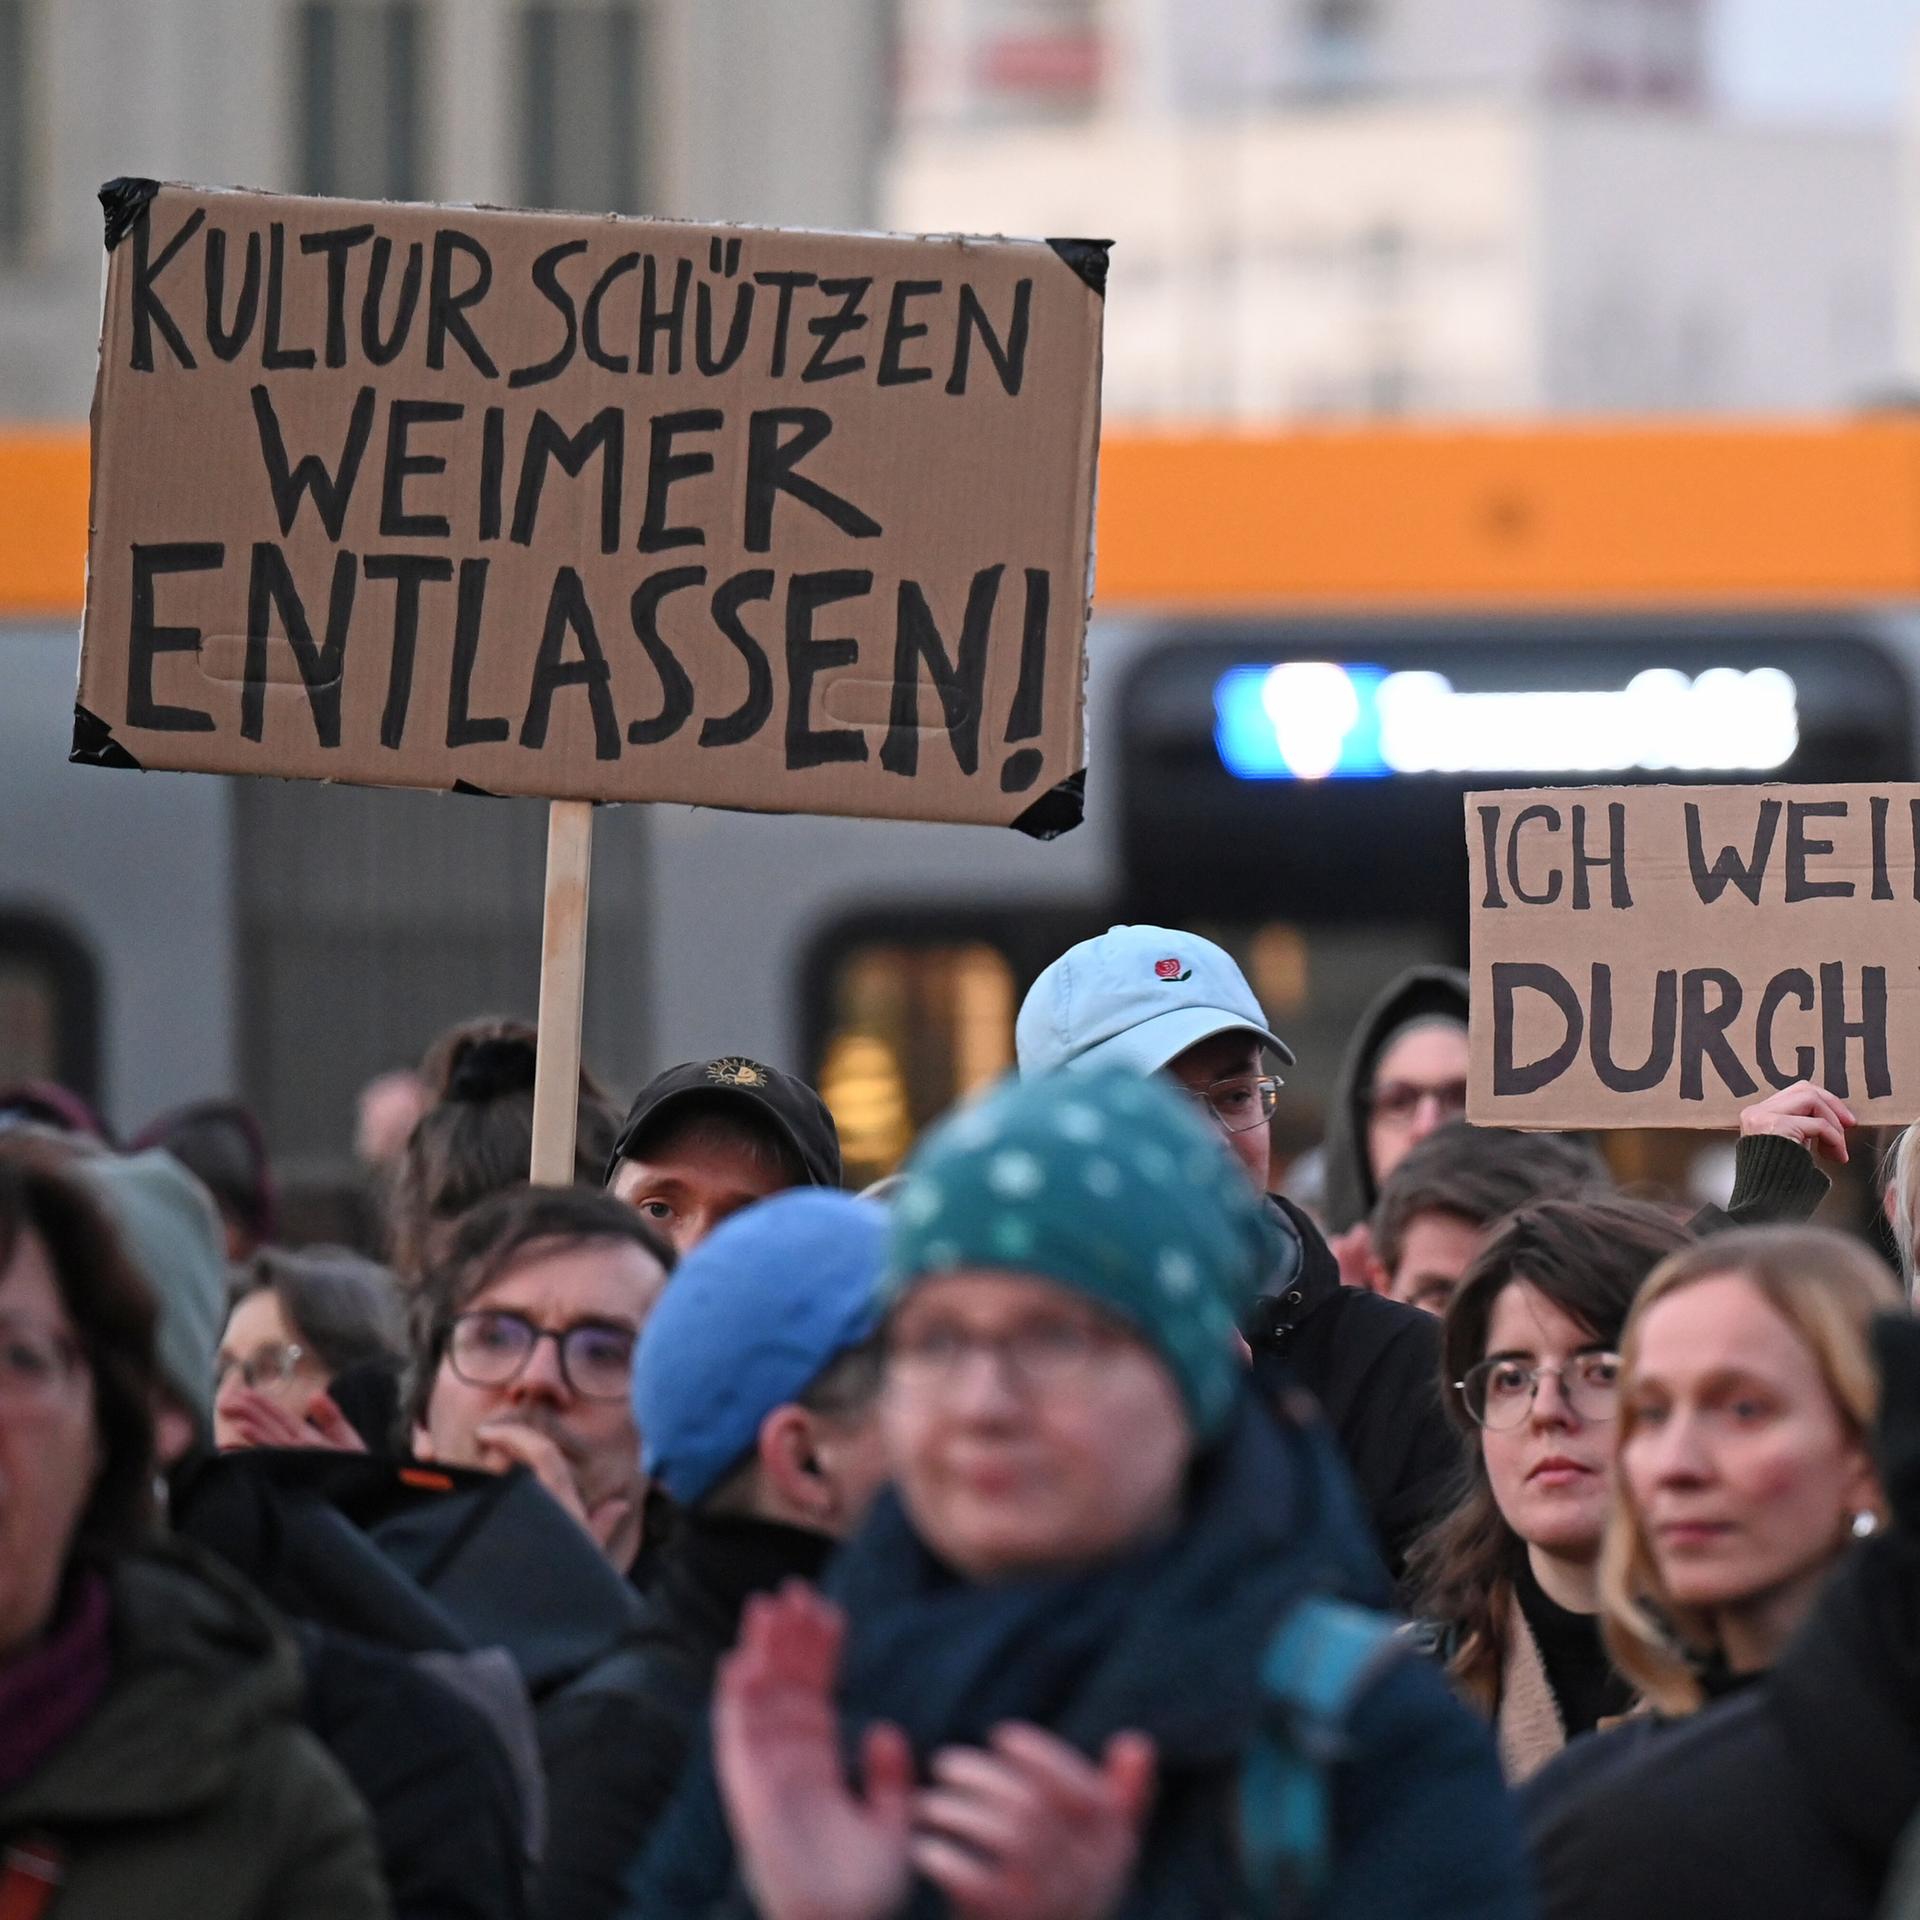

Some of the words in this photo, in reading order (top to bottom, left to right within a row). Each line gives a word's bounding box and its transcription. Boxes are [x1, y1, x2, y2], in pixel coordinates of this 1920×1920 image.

[129, 208, 500, 381] KULTUR
[251, 384, 883, 553] WEIMER
[125, 541, 1050, 792] ENTLASSEN!
[1477, 801, 1634, 910] ICH
[1684, 796, 1920, 906] WEI
[1491, 960, 1893, 1101] DURCH
